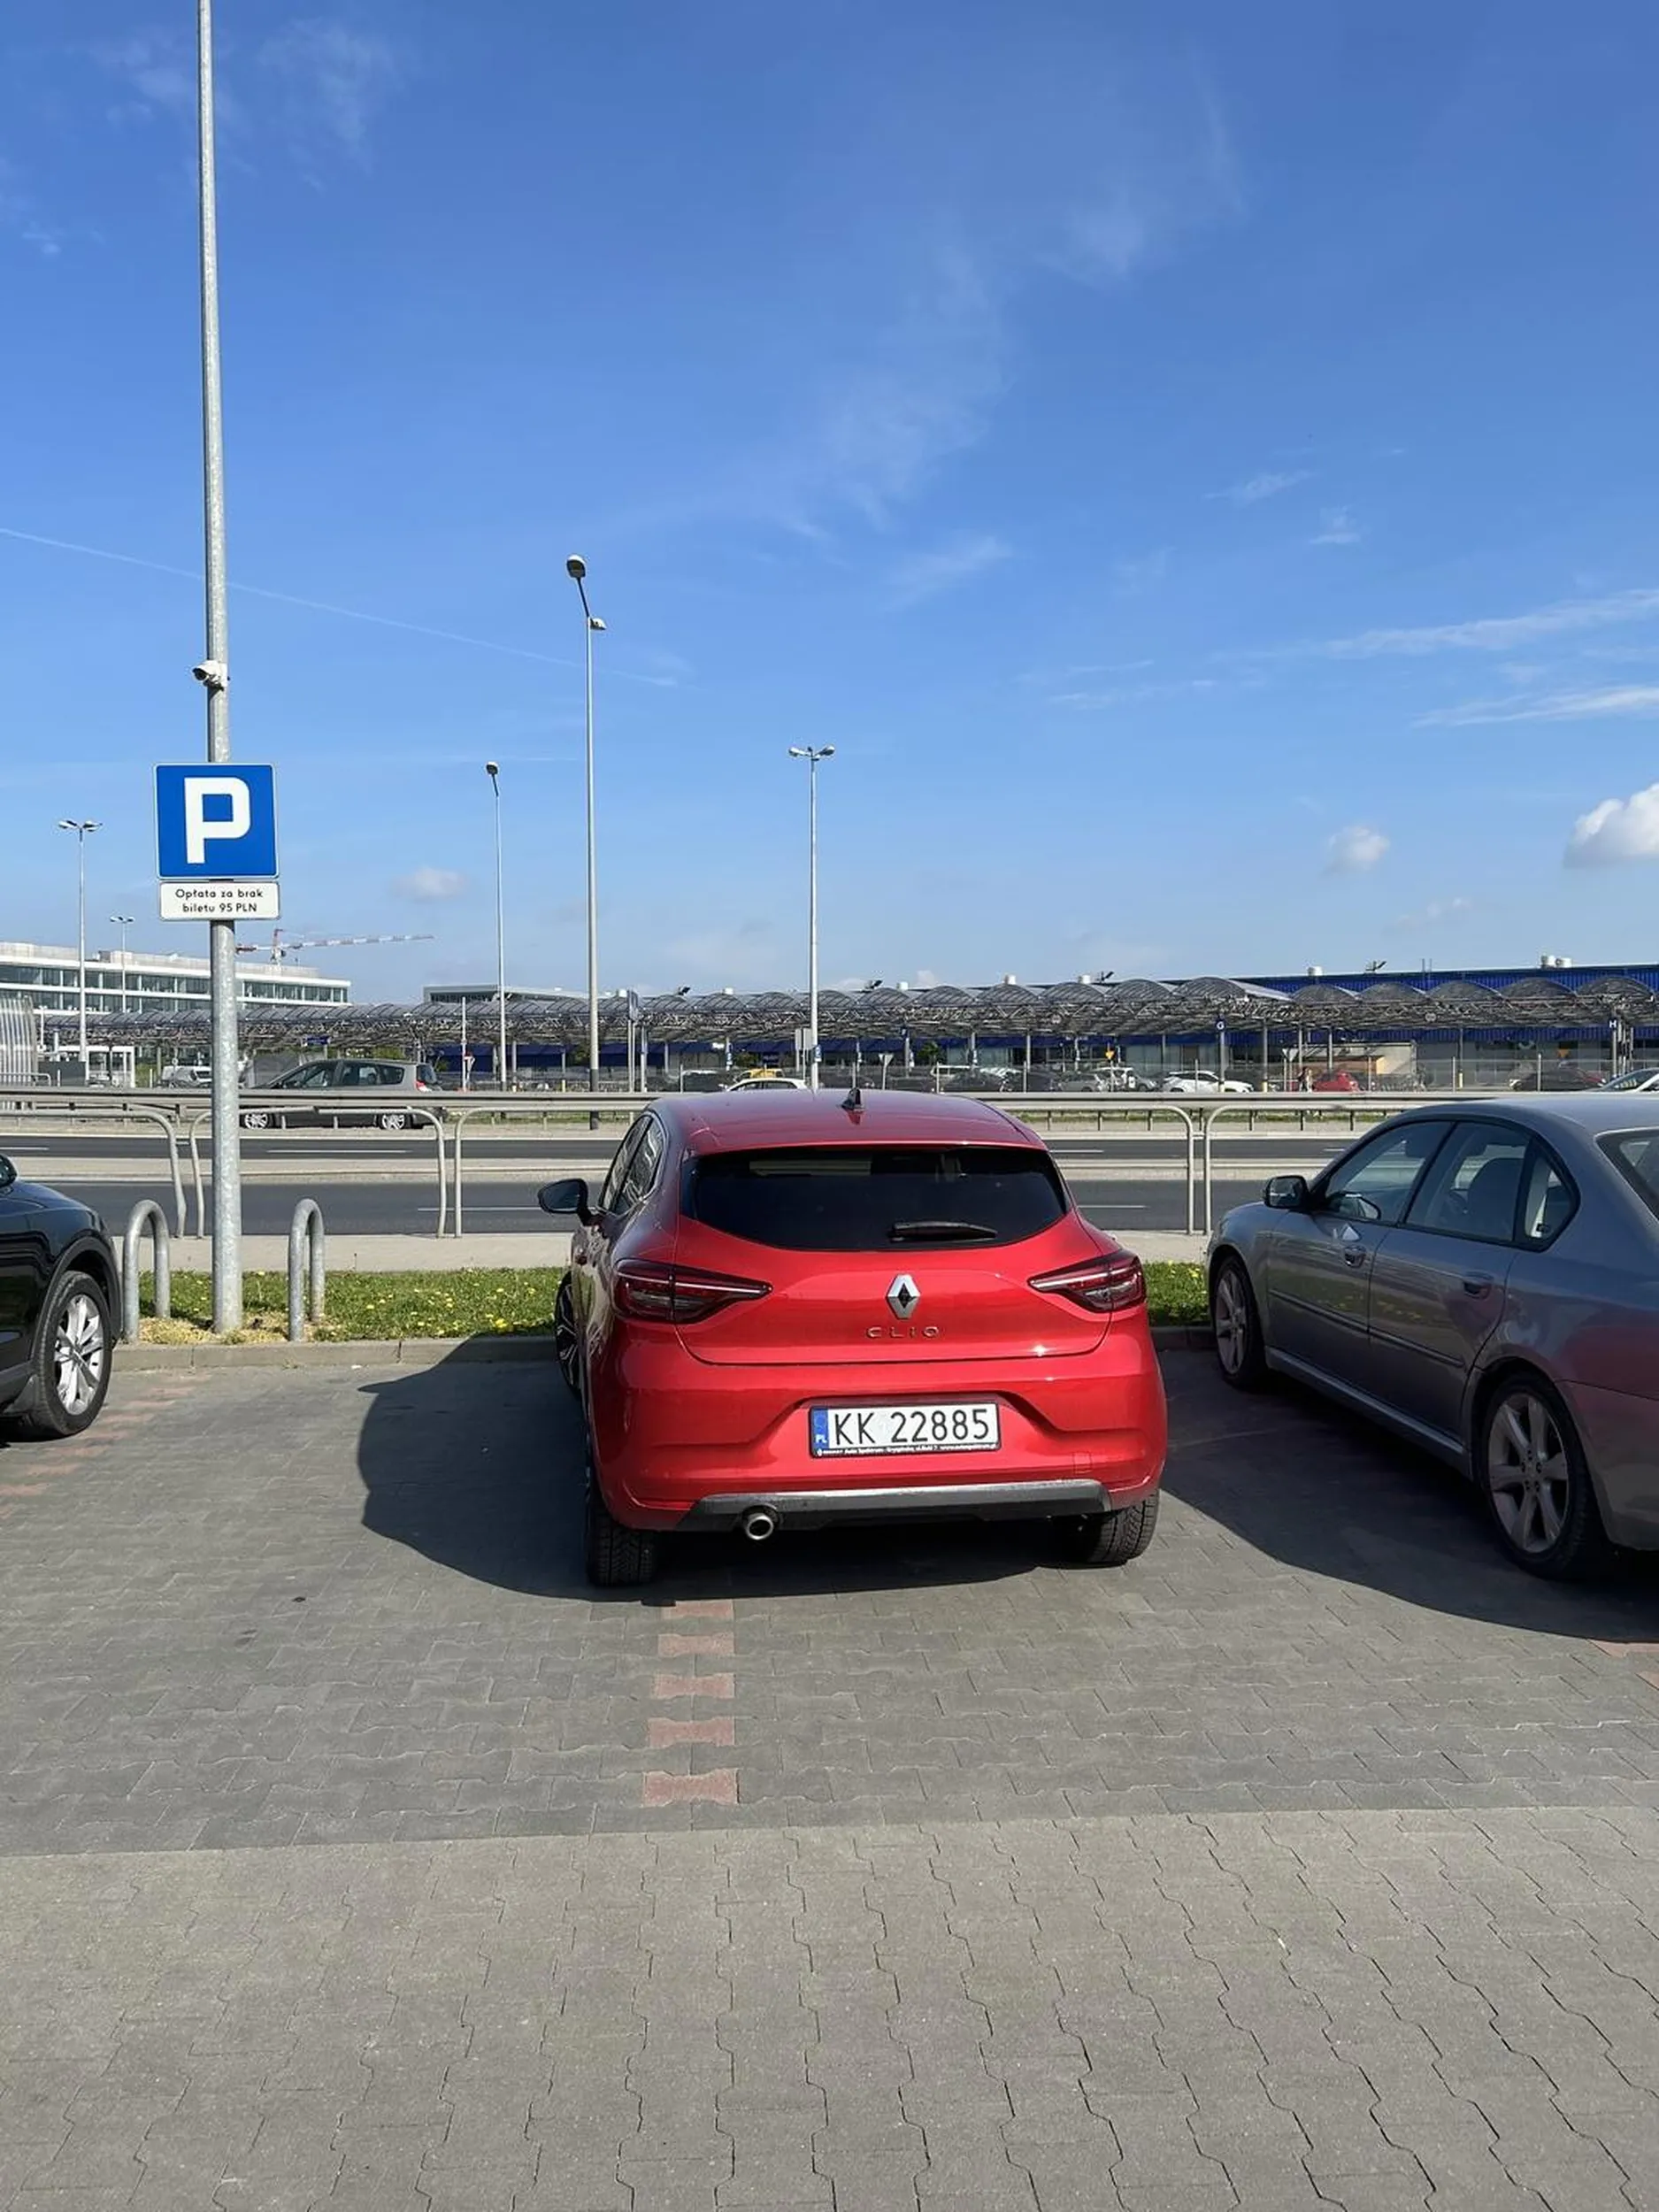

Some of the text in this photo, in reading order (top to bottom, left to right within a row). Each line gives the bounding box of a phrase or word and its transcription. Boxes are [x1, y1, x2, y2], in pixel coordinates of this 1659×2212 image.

[184, 777, 250, 864] P
[175, 888, 217, 901] Opłata
[237, 888, 264, 898] brak
[182, 902, 257, 912] biletu 95 PLN
[866, 1326, 940, 1339] CLIO
[834, 1408, 989, 1446] KK 22885
[815, 1433, 828, 1444] PL
